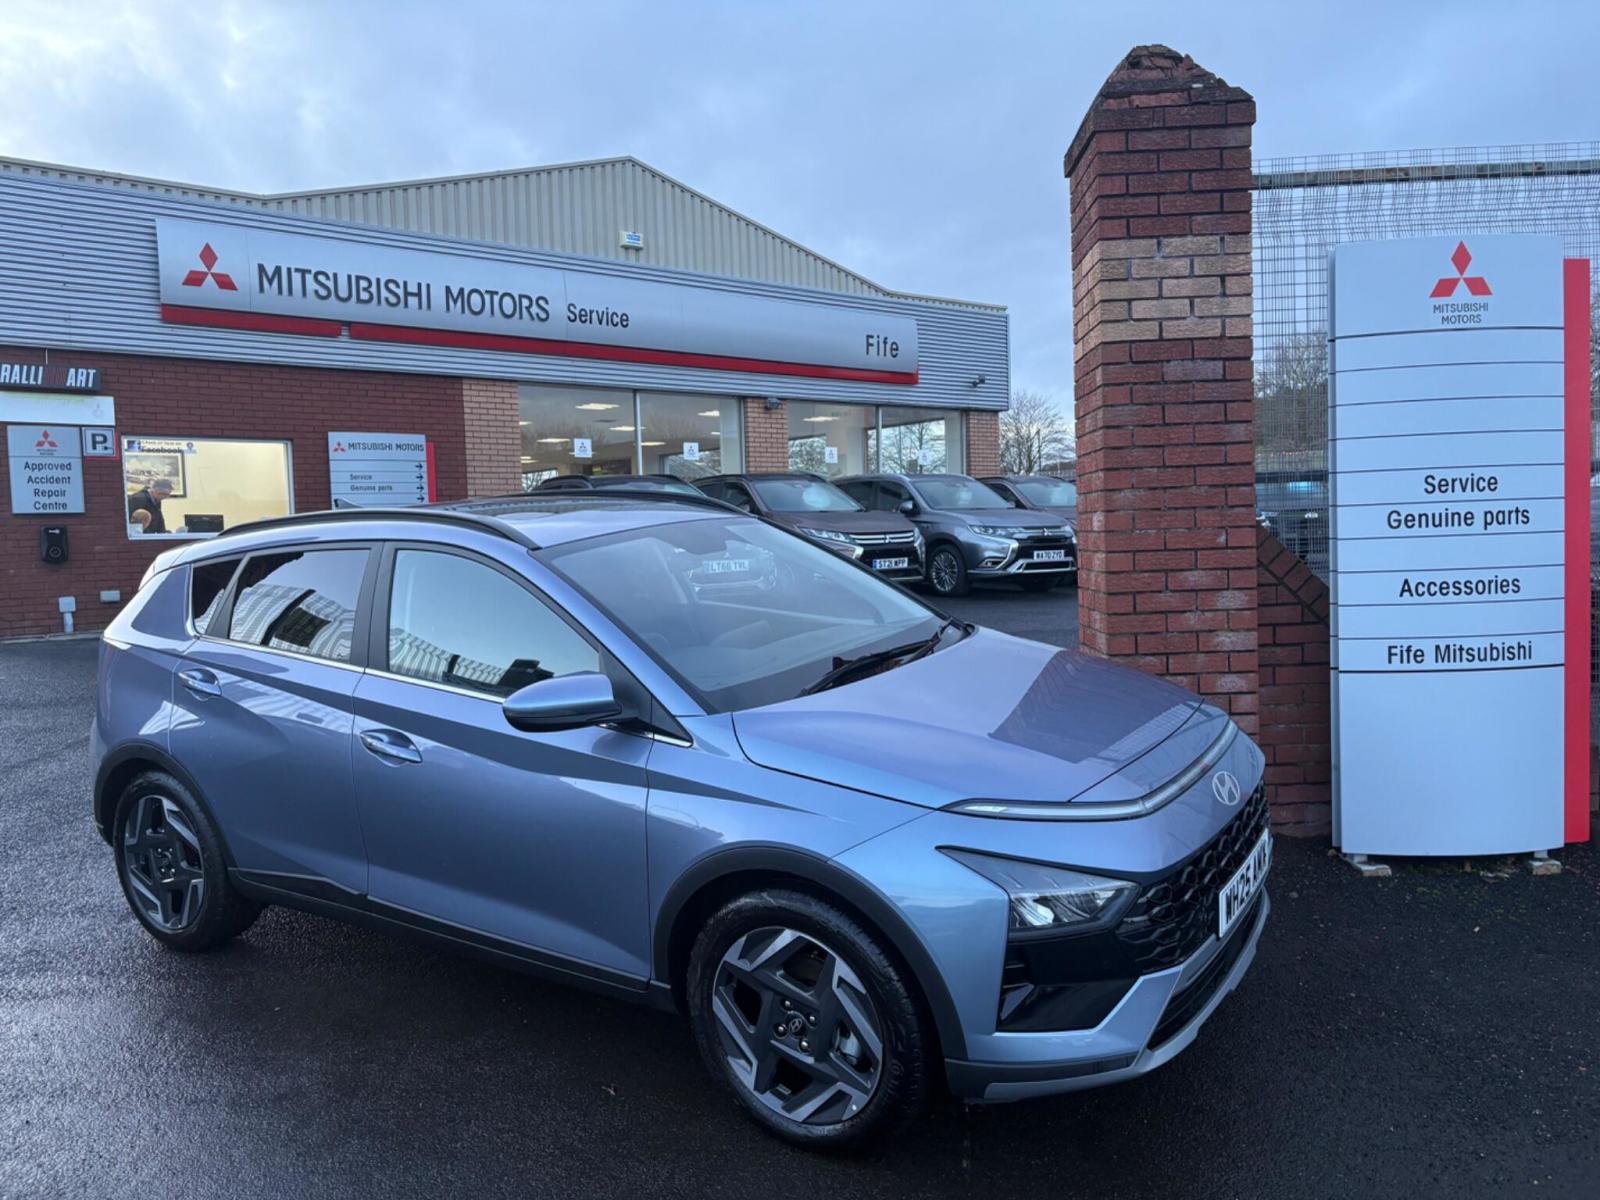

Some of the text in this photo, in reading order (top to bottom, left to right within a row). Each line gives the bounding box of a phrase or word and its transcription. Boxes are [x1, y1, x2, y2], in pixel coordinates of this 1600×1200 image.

[257, 263, 550, 322] MITSUBISHI MOTORS
[567, 303, 629, 328] Service
[1433, 303, 1488, 314] MITSUBISHI
[1441, 314, 1482, 325] MOTORS
[866, 334, 899, 358] Fife
[0, 363, 96, 388] RALLI ART
[91, 433, 108, 450] P
[348, 442, 424, 452] MITSUBISHI MOTORS
[24, 461, 72, 472] Approved
[27, 474, 71, 484] Accident
[1424, 473, 1498, 494] Service
[34, 488, 67, 499] Repair
[33, 501, 68, 511] Centre
[1387, 506, 1531, 531] Genuine parts
[1399, 575, 1521, 598] Accessories
[1388, 641, 1532, 664] Fife Mitsubishi
